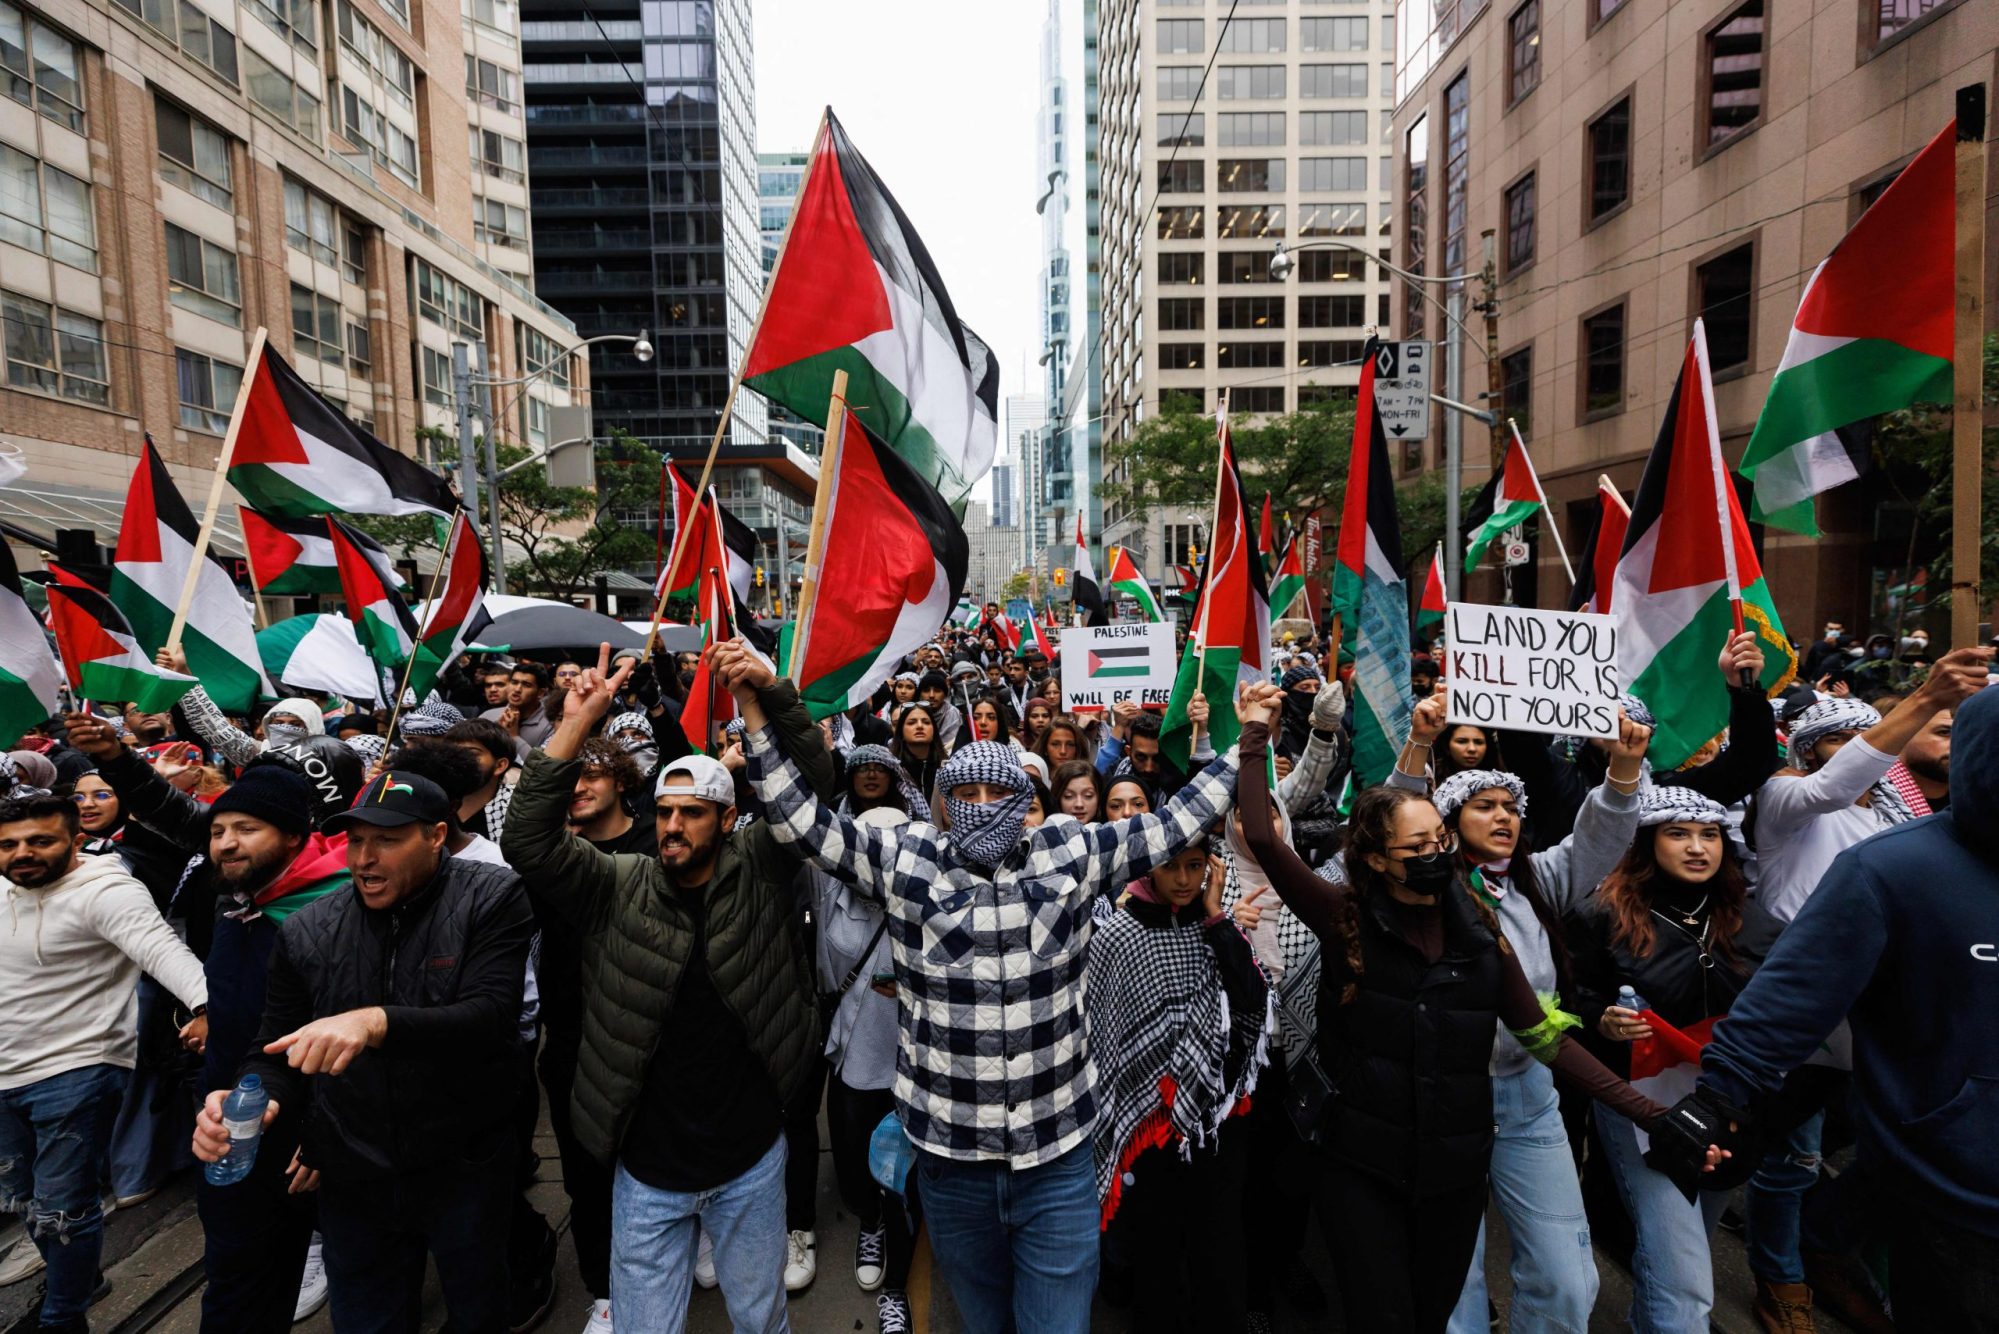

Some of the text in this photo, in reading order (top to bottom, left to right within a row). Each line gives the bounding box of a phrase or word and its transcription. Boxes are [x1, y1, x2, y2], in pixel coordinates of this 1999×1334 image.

[1379, 409, 1420, 419] MON-FRI
[1307, 516, 1320, 537] Tim
[1094, 625, 1149, 639] PALESTINE
[1453, 607, 1616, 663] LAND YOU
[1453, 650, 1619, 700] KILL FOR, IS
[1069, 689, 1170, 706] WILL BE FREE
[1453, 688, 1613, 734] NOT YOURS
[1970, 943, 1999, 962] C
